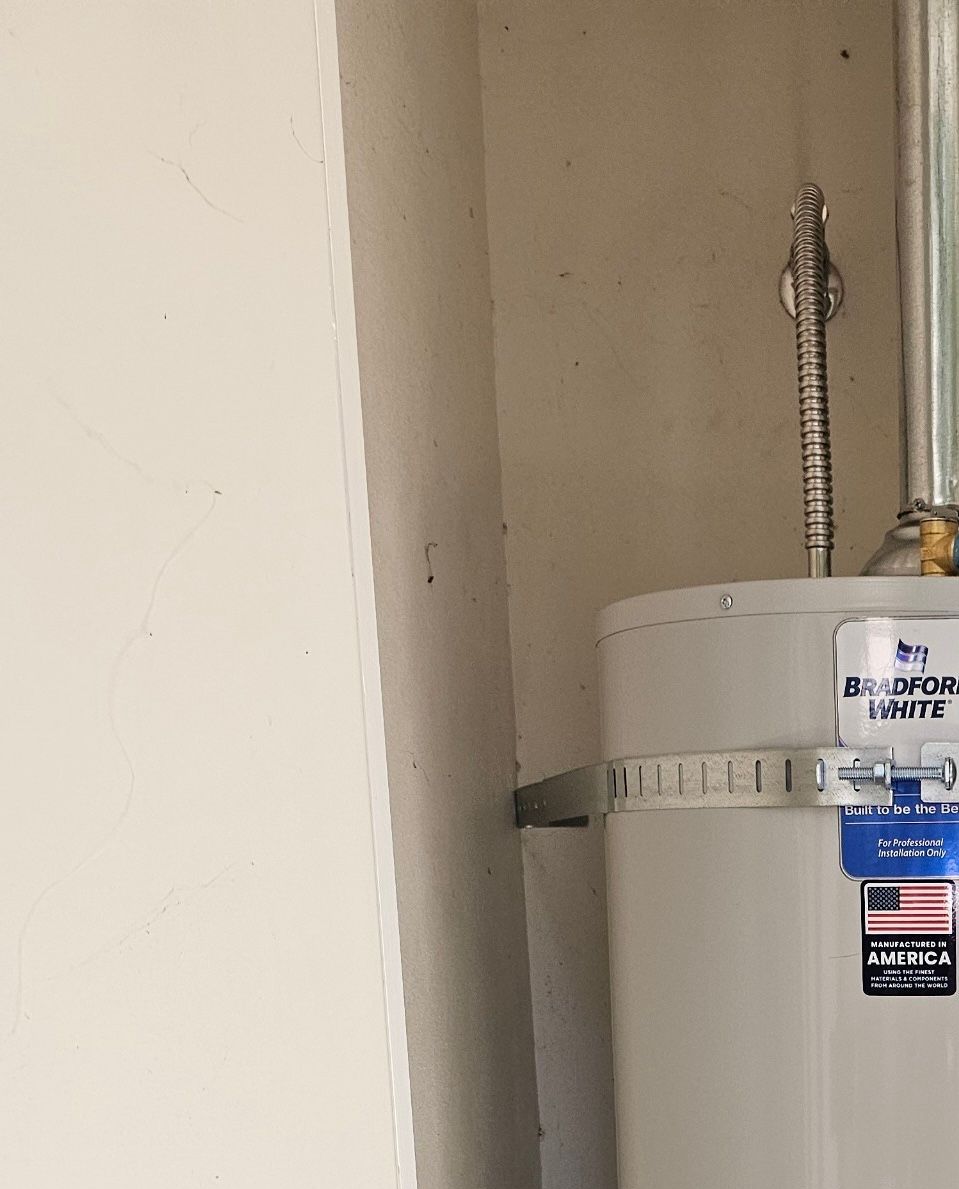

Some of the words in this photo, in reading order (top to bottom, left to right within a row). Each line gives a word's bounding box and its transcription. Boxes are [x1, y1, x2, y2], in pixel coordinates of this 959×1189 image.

[845, 806, 872, 815] Built
[877, 805, 889, 814] to
[894, 804, 910, 814] be
[915, 804, 936, 814] the
[878, 839, 890, 848] For
[893, 838, 944, 847] Professional
[878, 848, 925, 857] Installation
[926, 848, 946, 858] Only
[867, 951, 952, 966] AMERICA
